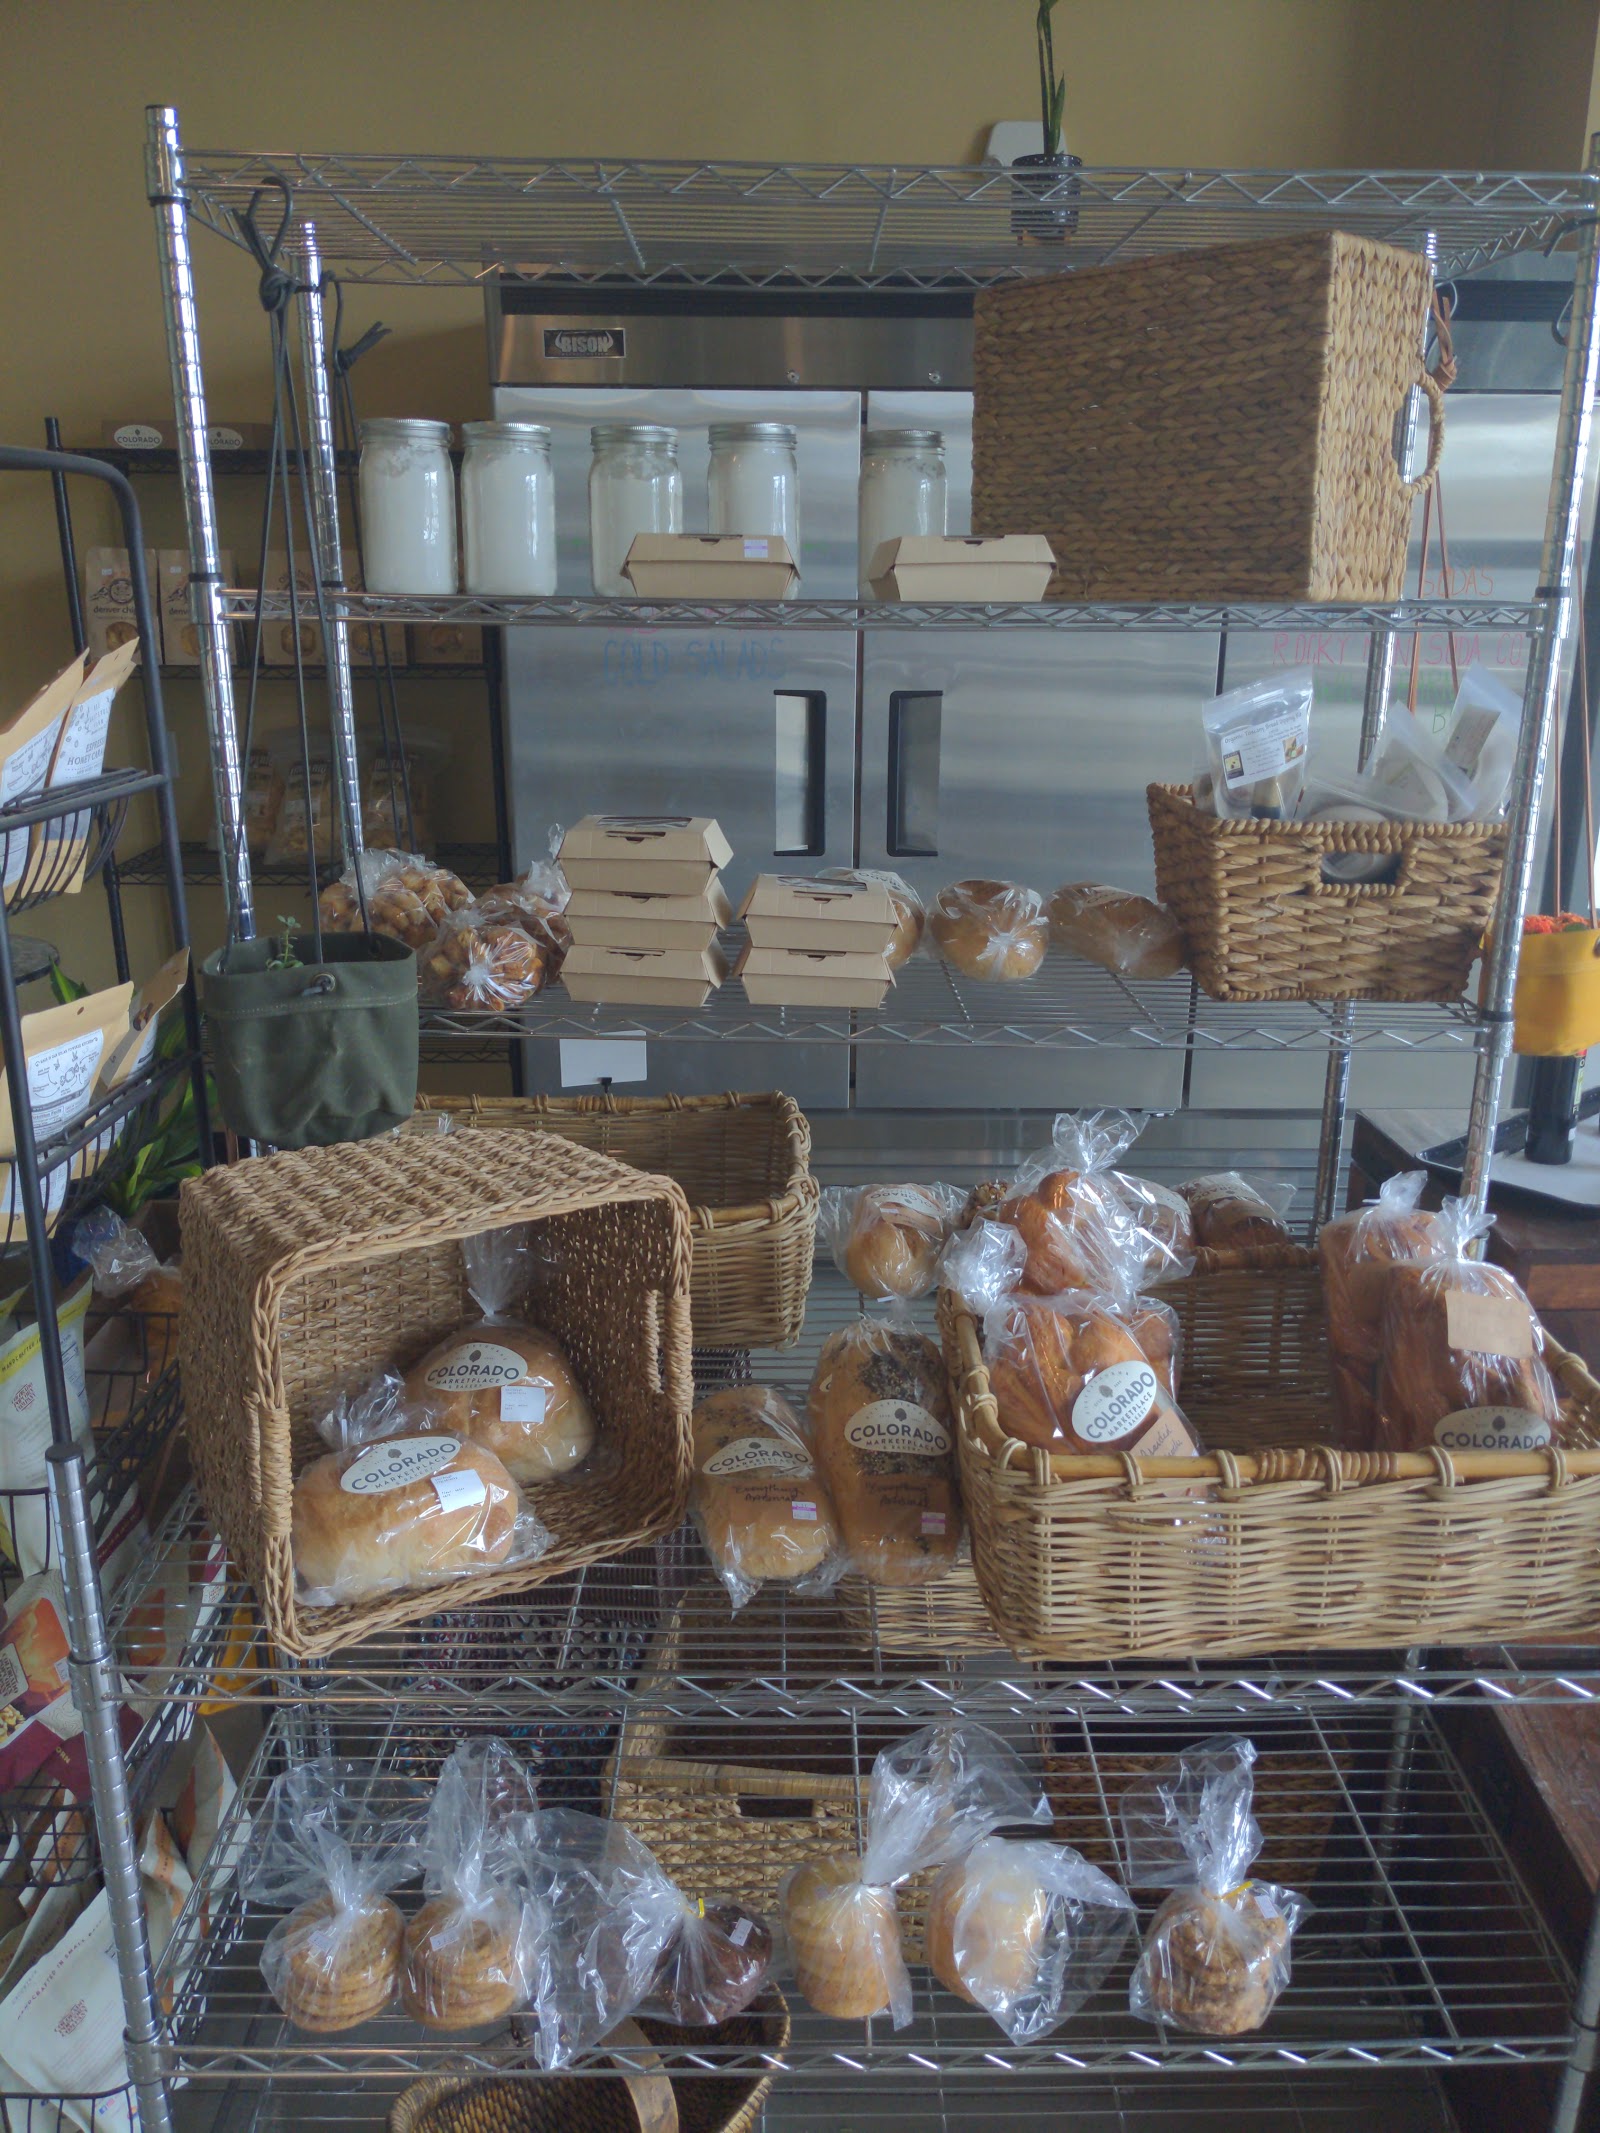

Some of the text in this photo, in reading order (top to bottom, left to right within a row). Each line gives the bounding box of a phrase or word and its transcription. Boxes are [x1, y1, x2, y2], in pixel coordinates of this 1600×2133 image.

[561, 336, 608, 353] BISON
[116, 435, 161, 445] COLORADO
[208, 437, 241, 446] LORADO
[93, 606, 120, 614] denver
[1272, 631, 1352, 666] ROCKY
[1423, 632, 1481, 666] SODA
[603, 635, 788, 688] COLD SALADS
[427, 1364, 520, 1382] COLORADO
[435, 1377, 502, 1385] MARKETPLACE
[1086, 1371, 1155, 1439] COLORADO
[1107, 1390, 1154, 1437] MARKETPLACE
[1128, 1406, 1148, 1427] BAKERY
[850, 1423, 947, 1450] COLORADO
[865, 1438, 935, 1452] MARKETPLACE
[1440, 1431, 1547, 1449] COLORADO
[351, 1443, 457, 1491] COLORADO
[709, 1448, 809, 1474] COLORADO
[375, 1455, 447, 1490] MARKETPLACE
